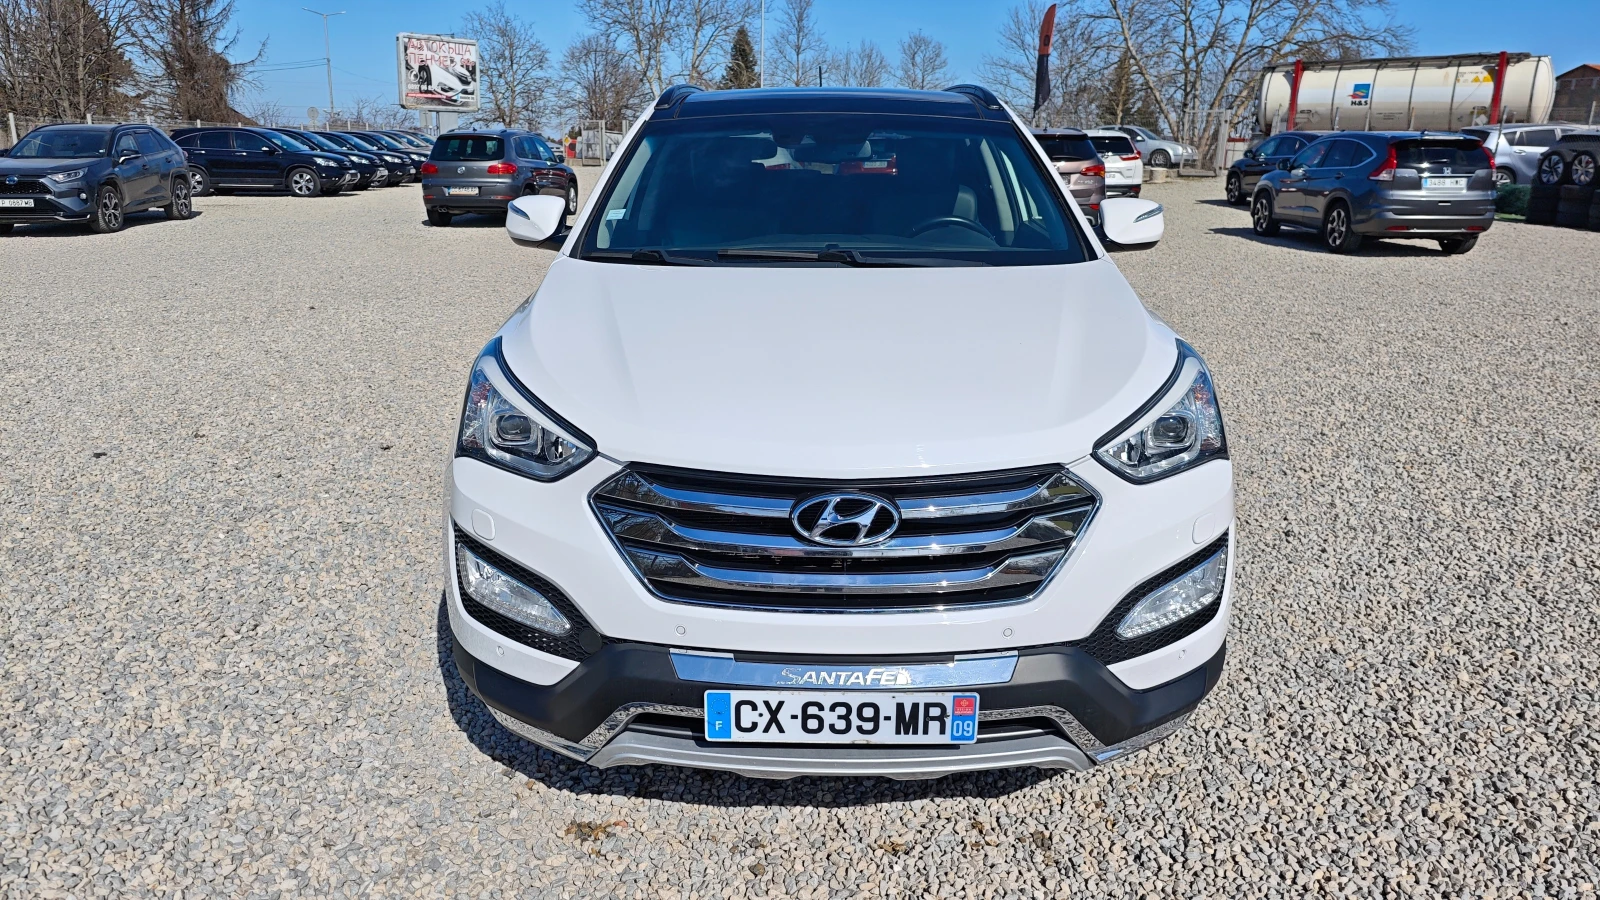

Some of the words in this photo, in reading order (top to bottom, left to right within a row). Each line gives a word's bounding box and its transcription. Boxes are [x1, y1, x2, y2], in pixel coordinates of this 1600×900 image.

[715, 720, 723, 731] F
[734, 699, 947, 735] CX-639-MR
[952, 720, 974, 737] 09
